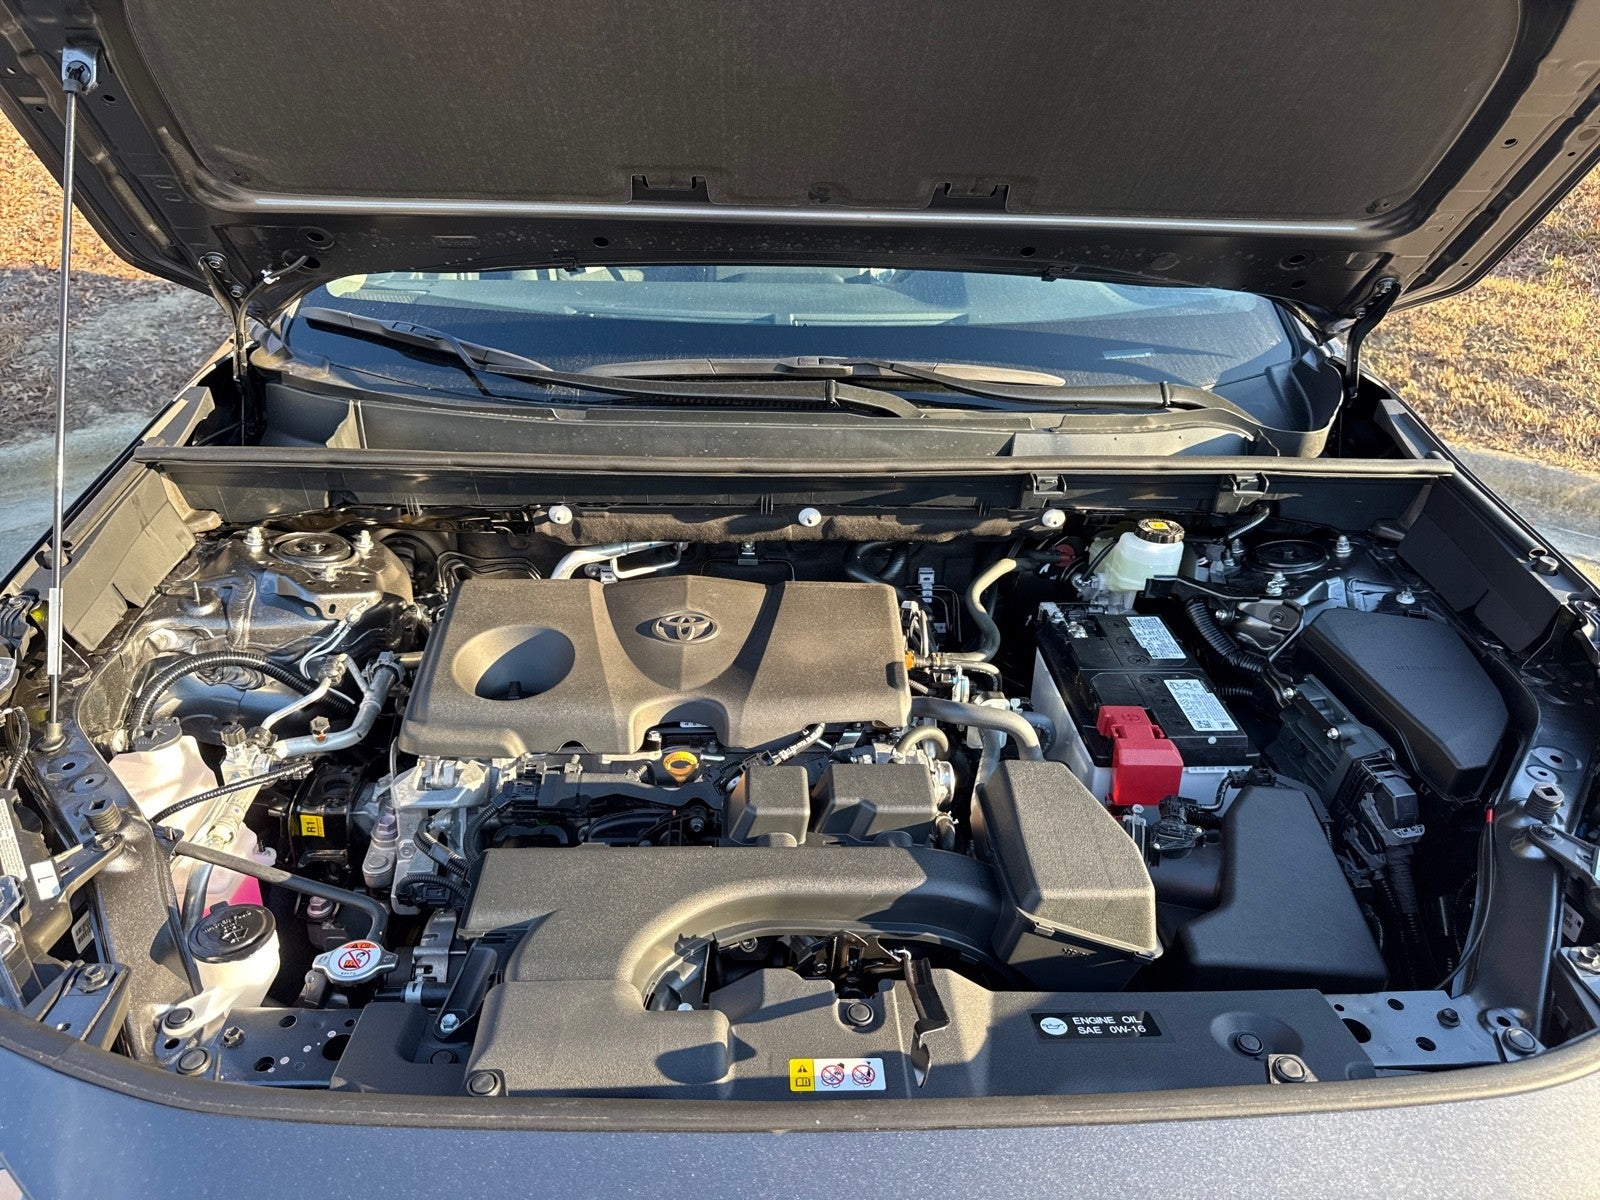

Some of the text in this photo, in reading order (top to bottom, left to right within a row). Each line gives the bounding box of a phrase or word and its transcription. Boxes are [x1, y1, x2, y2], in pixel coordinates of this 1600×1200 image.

[1072, 1015, 1142, 1025] ENGINE OIL
[1077, 1025, 1147, 1035] SAE 0W-16
